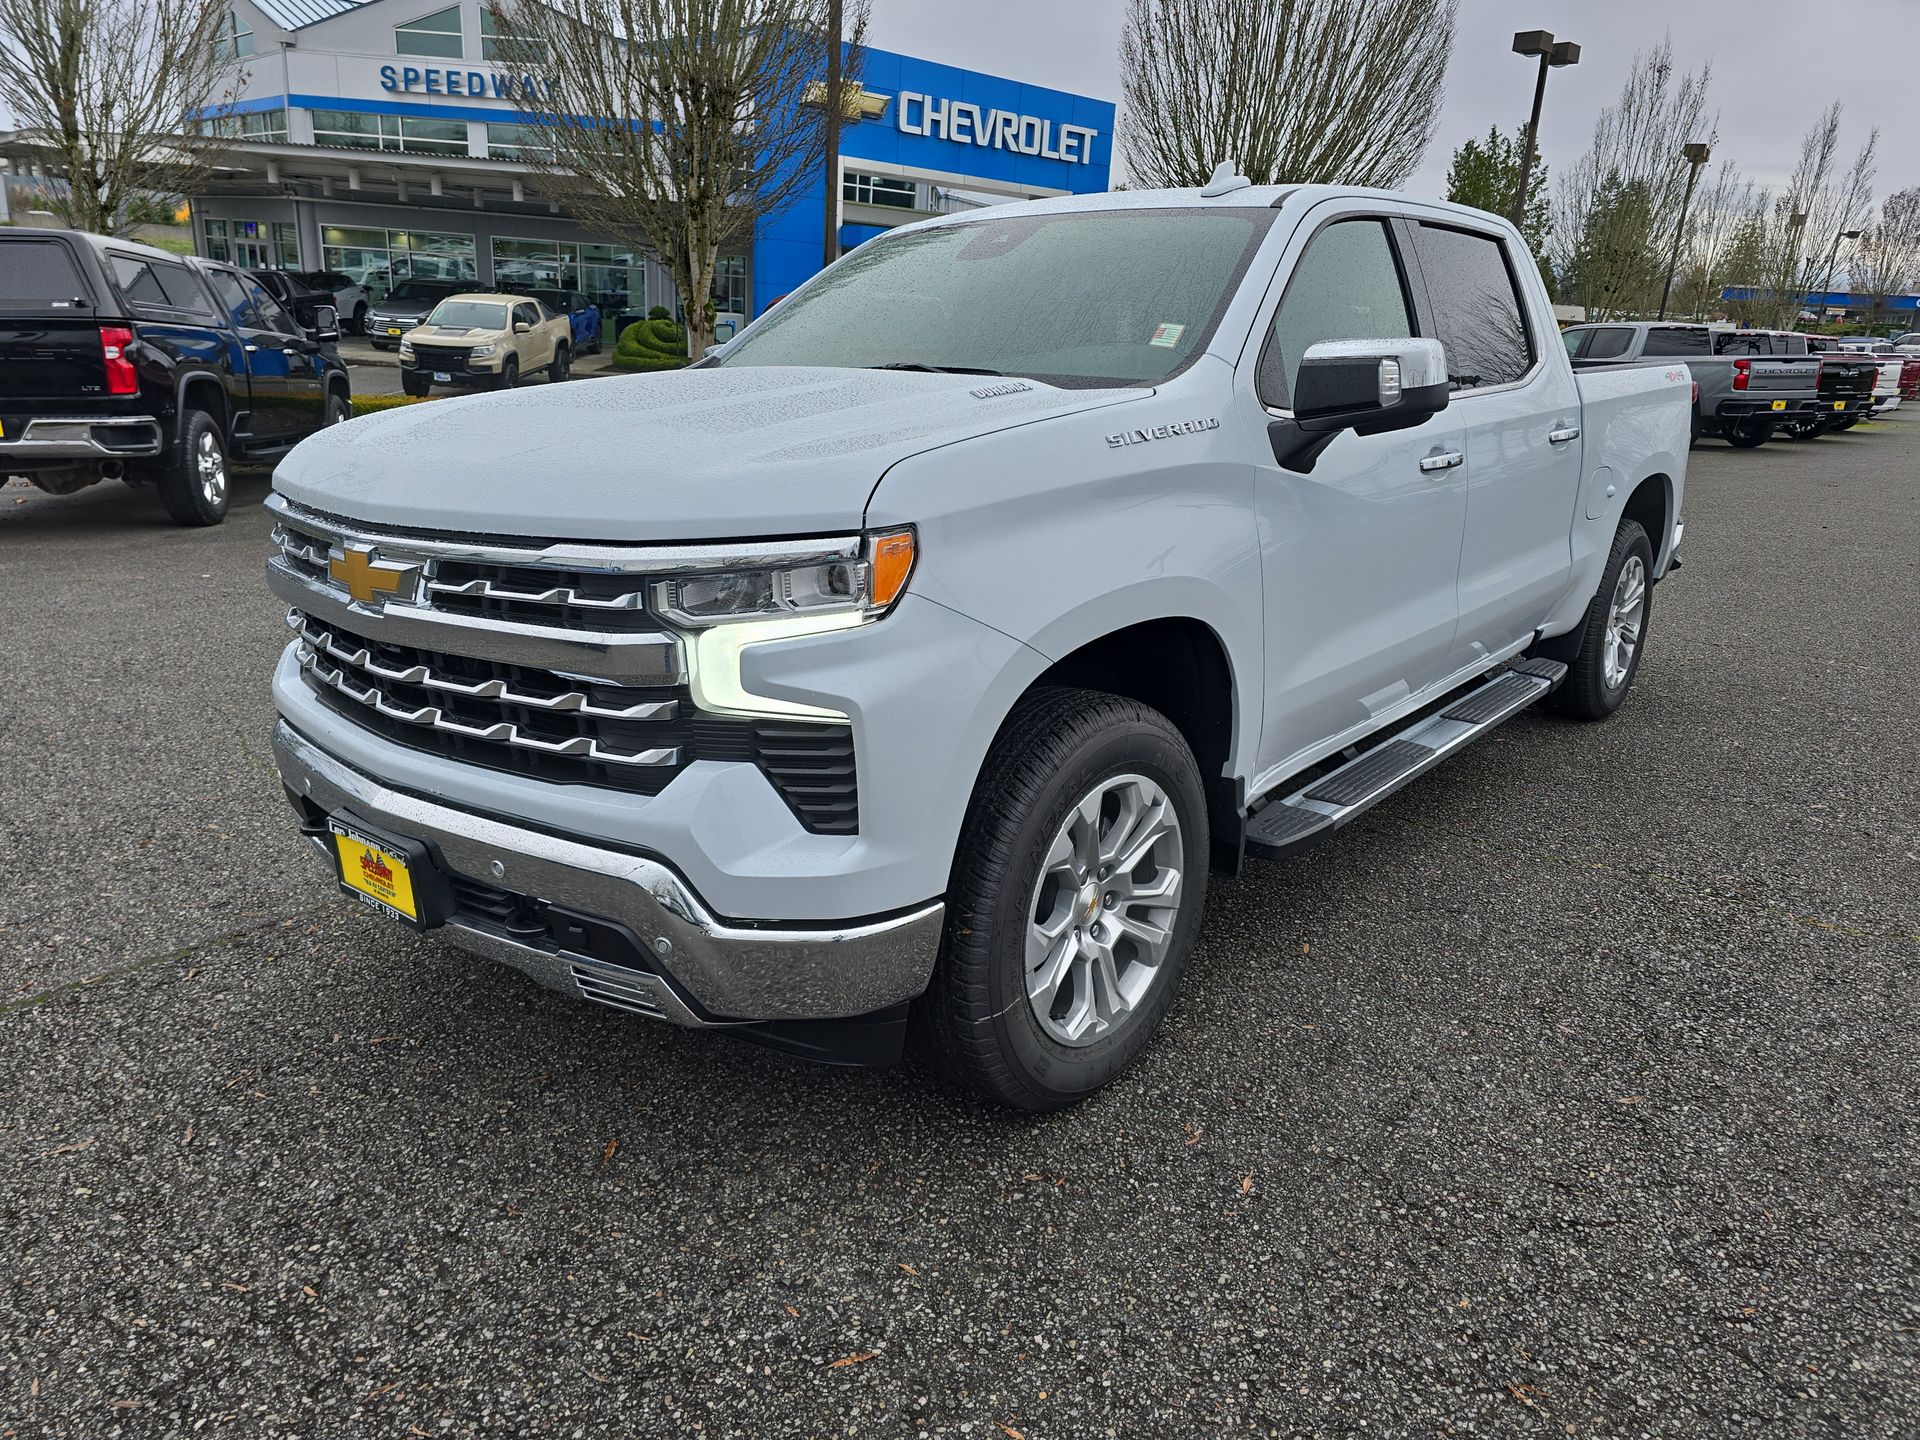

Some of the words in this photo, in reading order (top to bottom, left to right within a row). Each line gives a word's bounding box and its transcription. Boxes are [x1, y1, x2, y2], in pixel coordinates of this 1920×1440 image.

[898, 90, 1098, 165] CHEVROLET
[1105, 416, 1219, 448] SILVERADO
[348, 828, 381, 853] Johnson
[359, 893, 380, 910] SINCE
[382, 905, 400, 921] 1933
